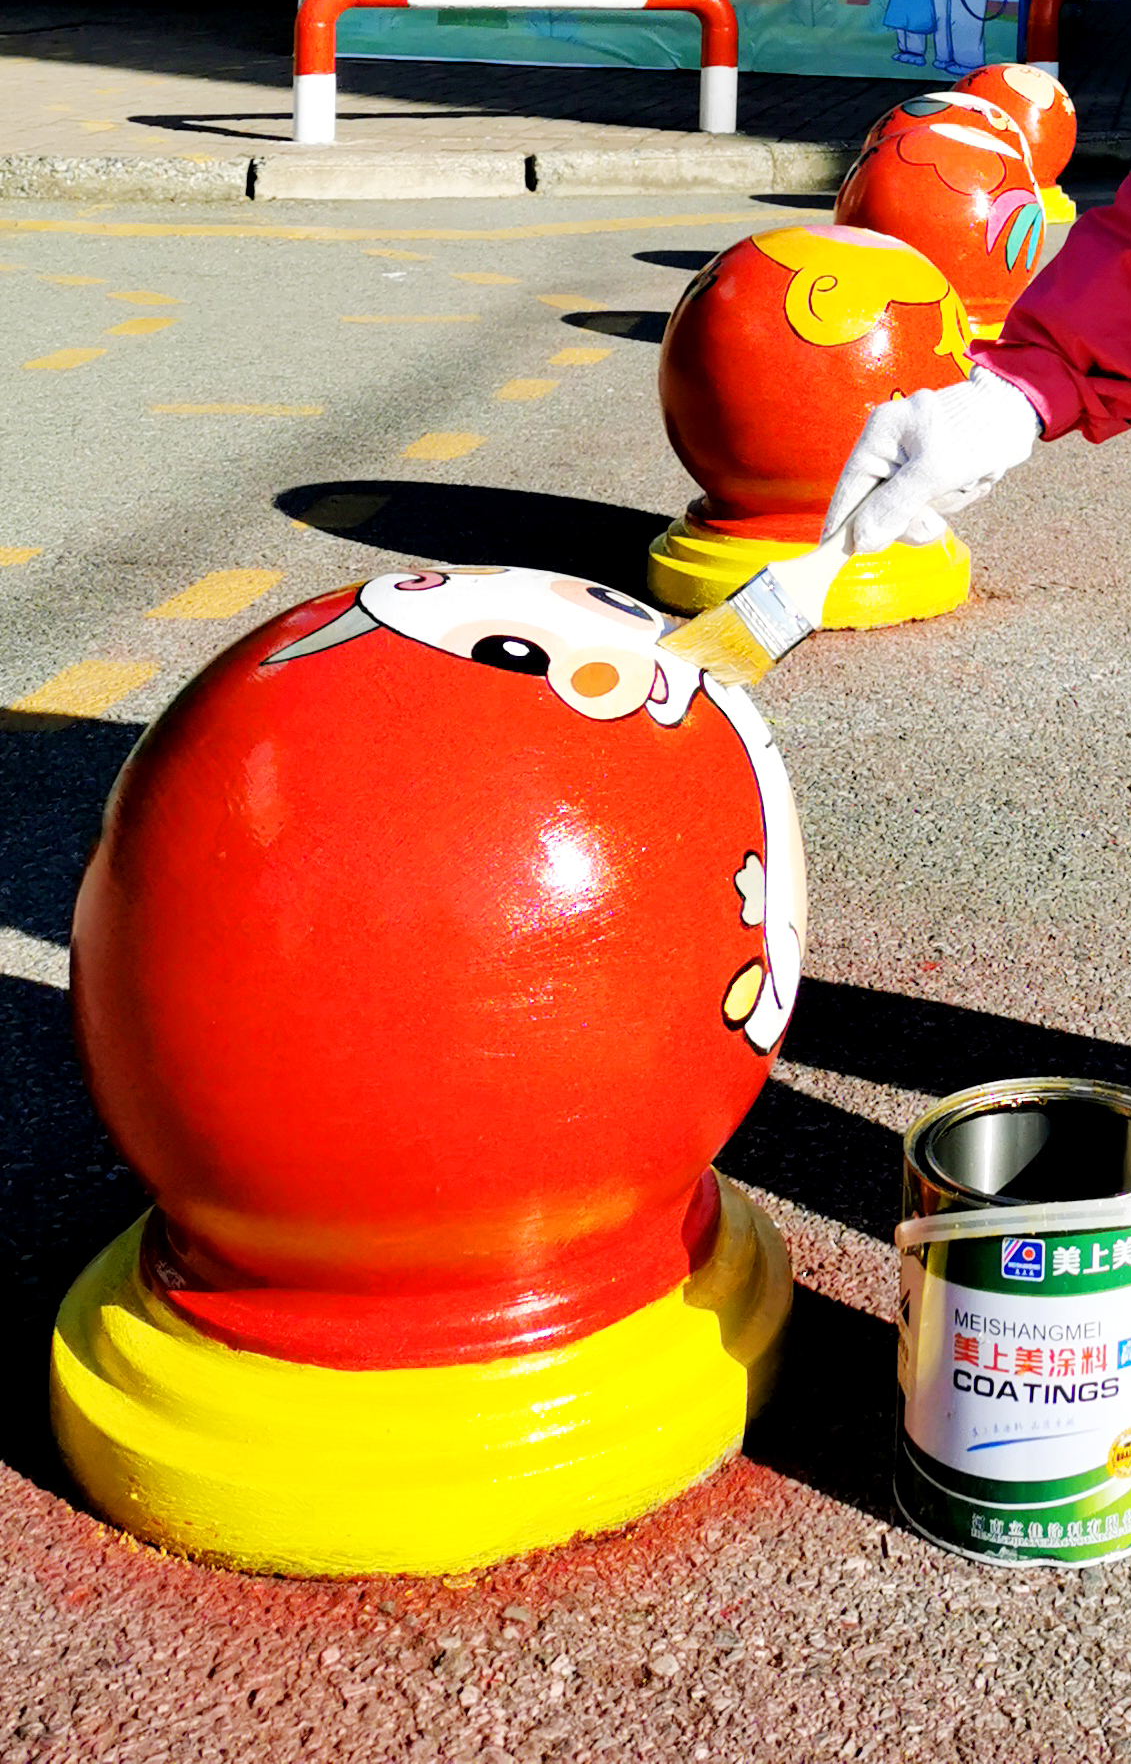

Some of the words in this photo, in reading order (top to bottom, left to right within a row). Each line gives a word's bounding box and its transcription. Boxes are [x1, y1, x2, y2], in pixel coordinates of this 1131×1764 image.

[954, 1308, 1102, 1342] MEISHANGMEI
[953, 1332, 1108, 1378] 美上美涂料
[952, 1368, 1120, 1405] COATINGS
